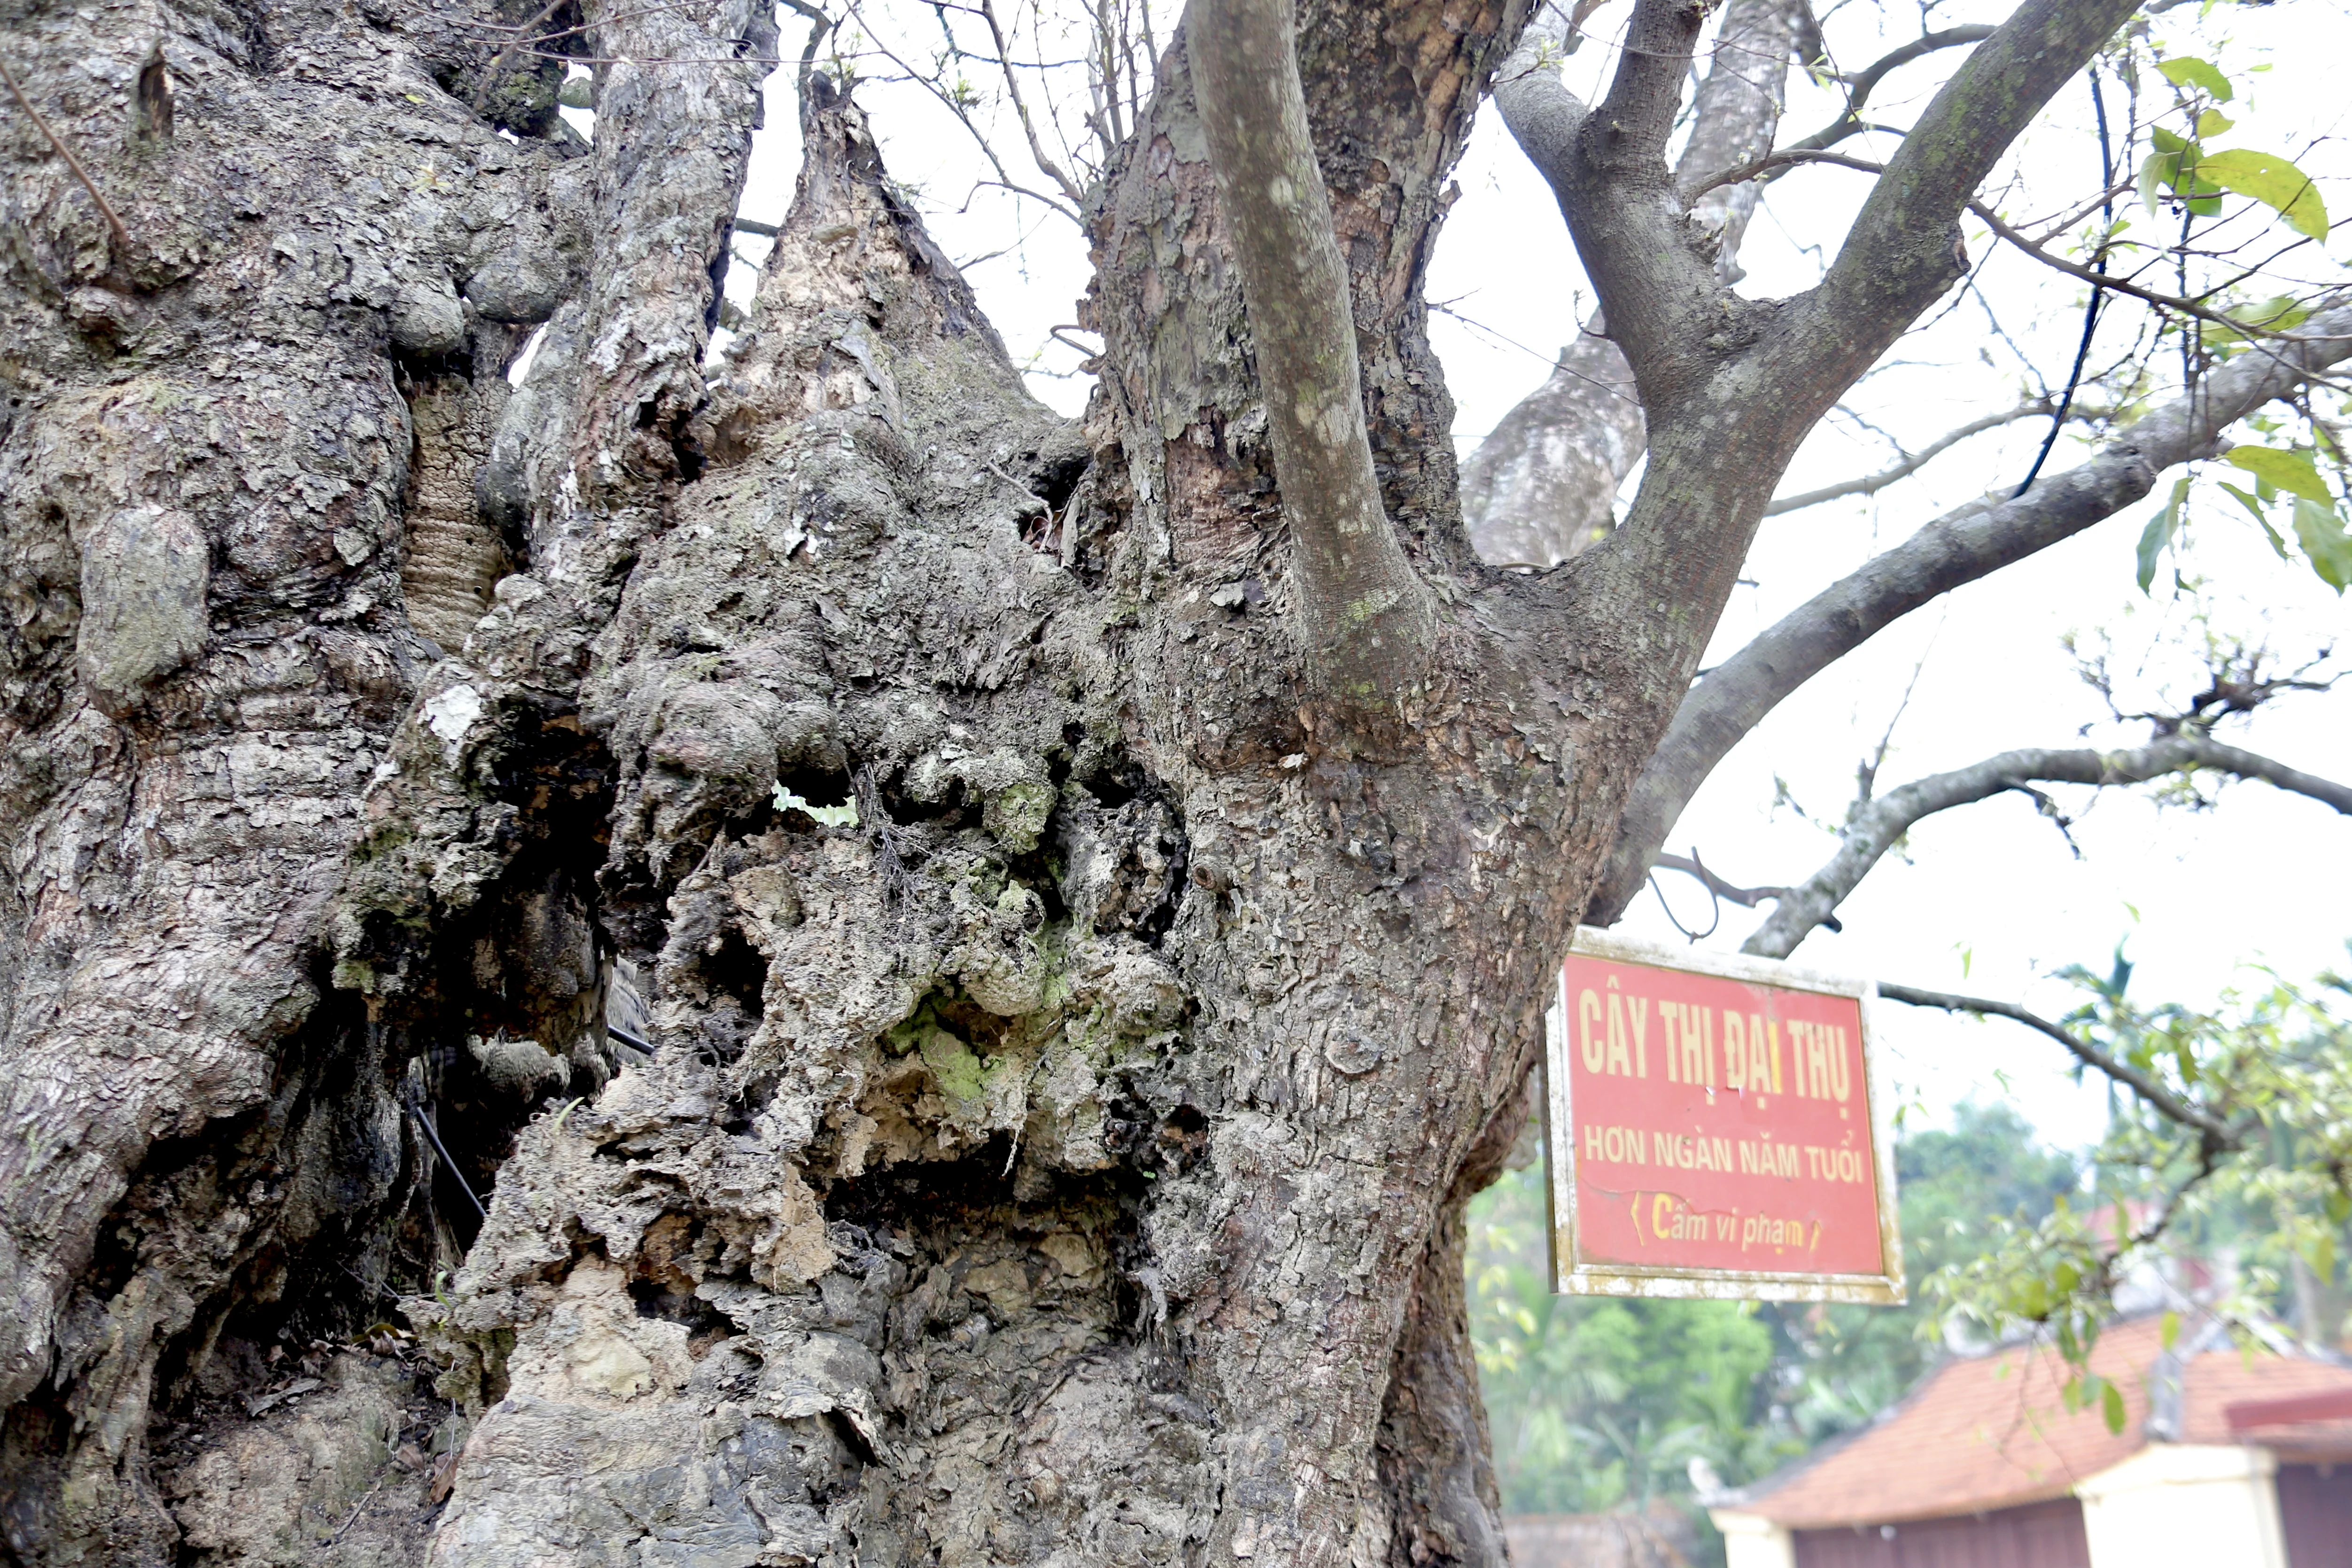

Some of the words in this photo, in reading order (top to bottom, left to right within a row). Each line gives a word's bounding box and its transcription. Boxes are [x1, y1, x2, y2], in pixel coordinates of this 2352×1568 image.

[1578, 975, 1647, 1078] CÂY
[1658, 1000, 1715, 1105] THỊ
[1723, 1009, 1782, 1109] ĐẠI
[1787, 1019, 1849, 1119] THỤ
[1584, 1125, 1645, 1164] HƠN
[1653, 1126, 1733, 1172] NGÀN
[1739, 1132, 1800, 1177] NĂM
[1805, 1131, 1864, 1183] TUỔI
[1715, 1207, 1736, 1242] vi
